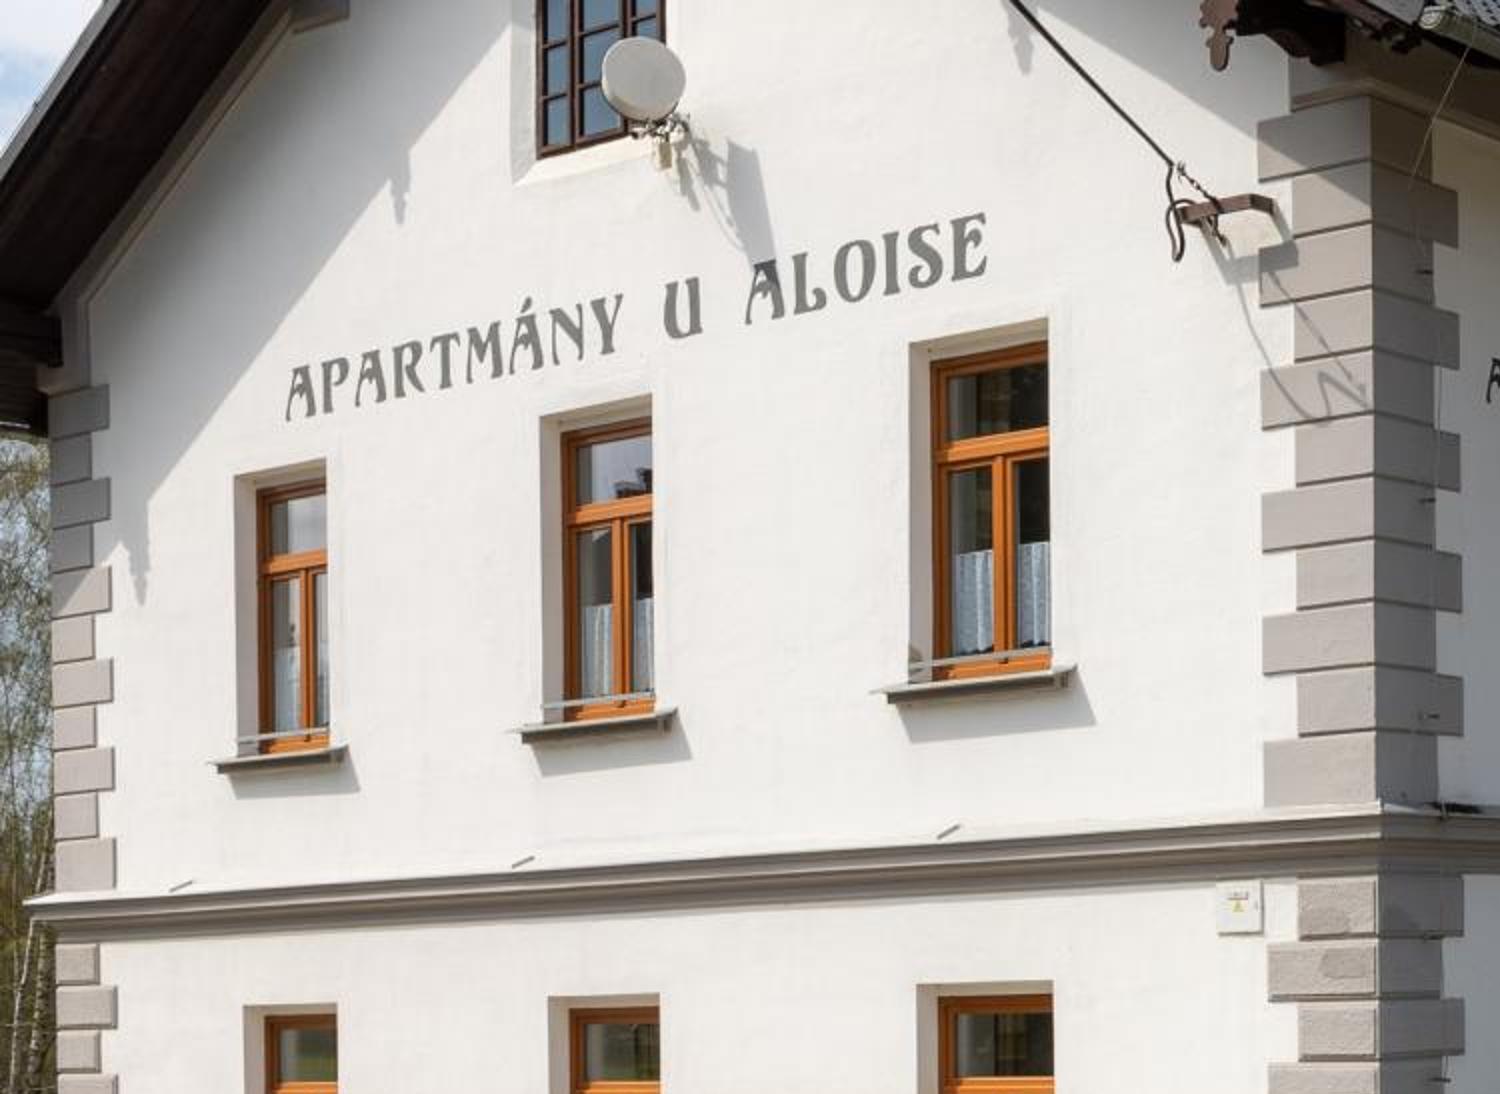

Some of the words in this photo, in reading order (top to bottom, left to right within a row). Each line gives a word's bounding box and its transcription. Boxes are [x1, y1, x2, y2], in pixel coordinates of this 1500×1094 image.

[285, 294, 624, 421] APARTMÁNY
[664, 277, 703, 340] U
[745, 212, 989, 325] ALOISE
